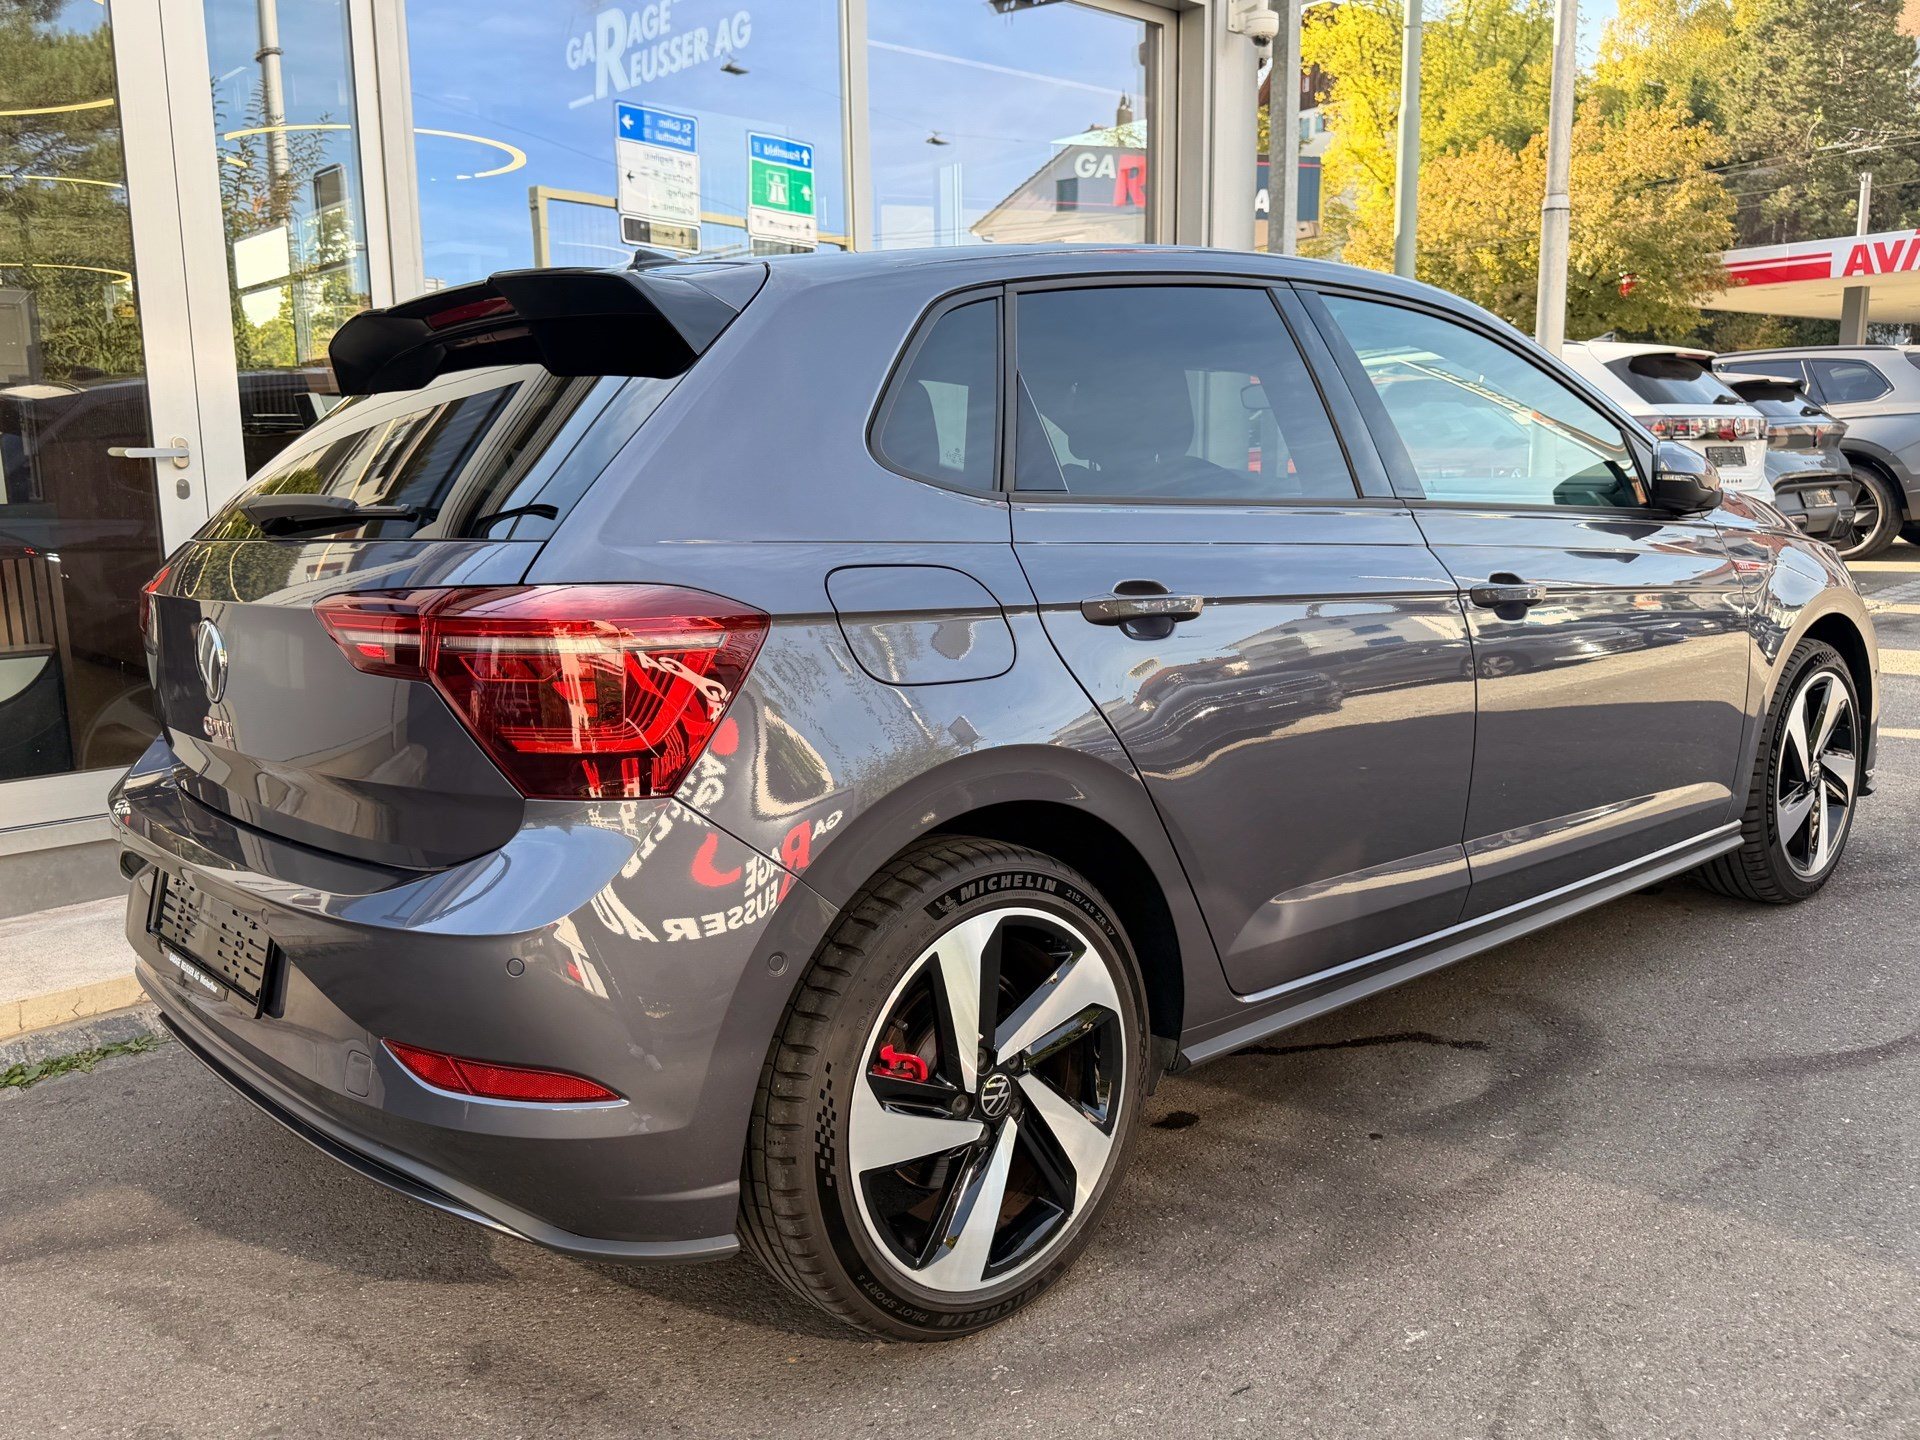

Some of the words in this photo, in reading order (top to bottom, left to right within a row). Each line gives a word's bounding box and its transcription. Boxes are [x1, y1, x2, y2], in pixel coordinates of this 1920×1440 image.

[566, 0, 671, 99] GARAGE
[713, 10, 752, 57] AG
[1767, 749, 1777, 825] MICHELIN
[960, 874, 1058, 902] MICHELIN
[1065, 889, 1096, 914] 215/45
[1094, 912, 1107, 926] ZR
[1105, 925, 1116, 937] 17
[863, 1281, 898, 1309] SPORT
[897, 1305, 929, 1323] PILOT
